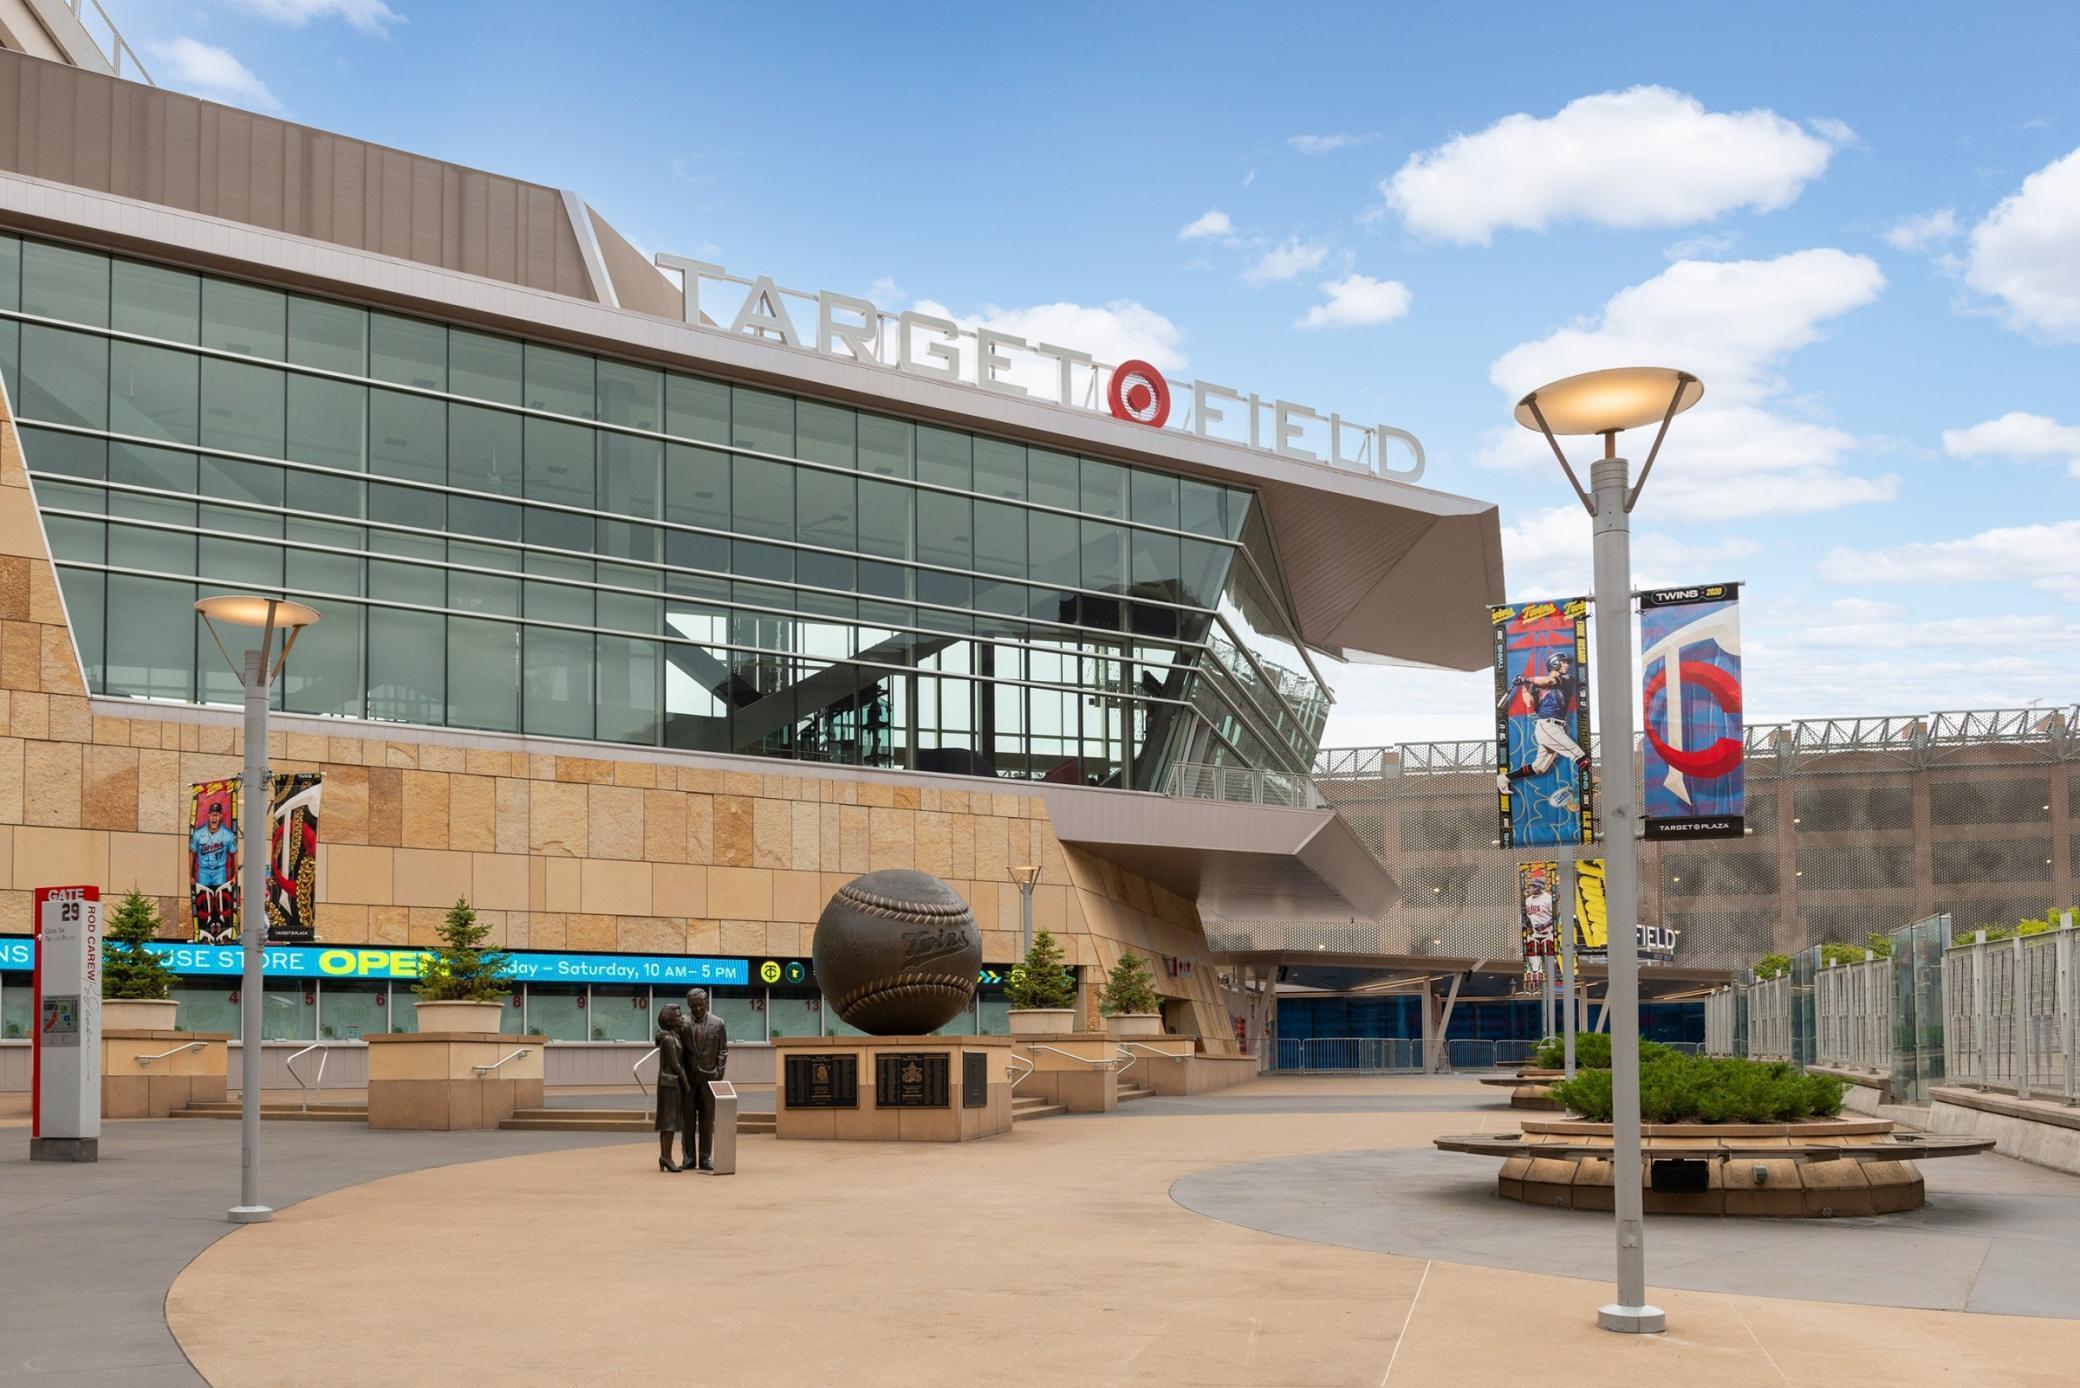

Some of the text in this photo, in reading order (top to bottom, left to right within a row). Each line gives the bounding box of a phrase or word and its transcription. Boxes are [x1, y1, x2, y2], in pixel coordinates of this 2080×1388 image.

[655, 252, 1426, 483] TARGET FIELD
[1656, 590, 1698, 601] TWINS
[48, 889, 84, 901] GATE
[61, 903, 79, 921] 29
[87, 906, 96, 933] ROD
[87, 936, 96, 981] CAREW
[558, 961, 639, 979] Saturday,
[643, 962, 659, 977] 10
[702, 964, 711, 978] 5
[715, 967, 737, 979] PM
[229, 991, 239, 1005] 4
[305, 992, 314, 1005] 5
[375, 993, 386, 1006] 6
[512, 995, 522, 1008] 8
[576, 996, 586, 1008] 9
[631, 997, 647, 1009] 10
[749, 998, 764, 1011] 12
[805, 999, 820, 1012] 13
